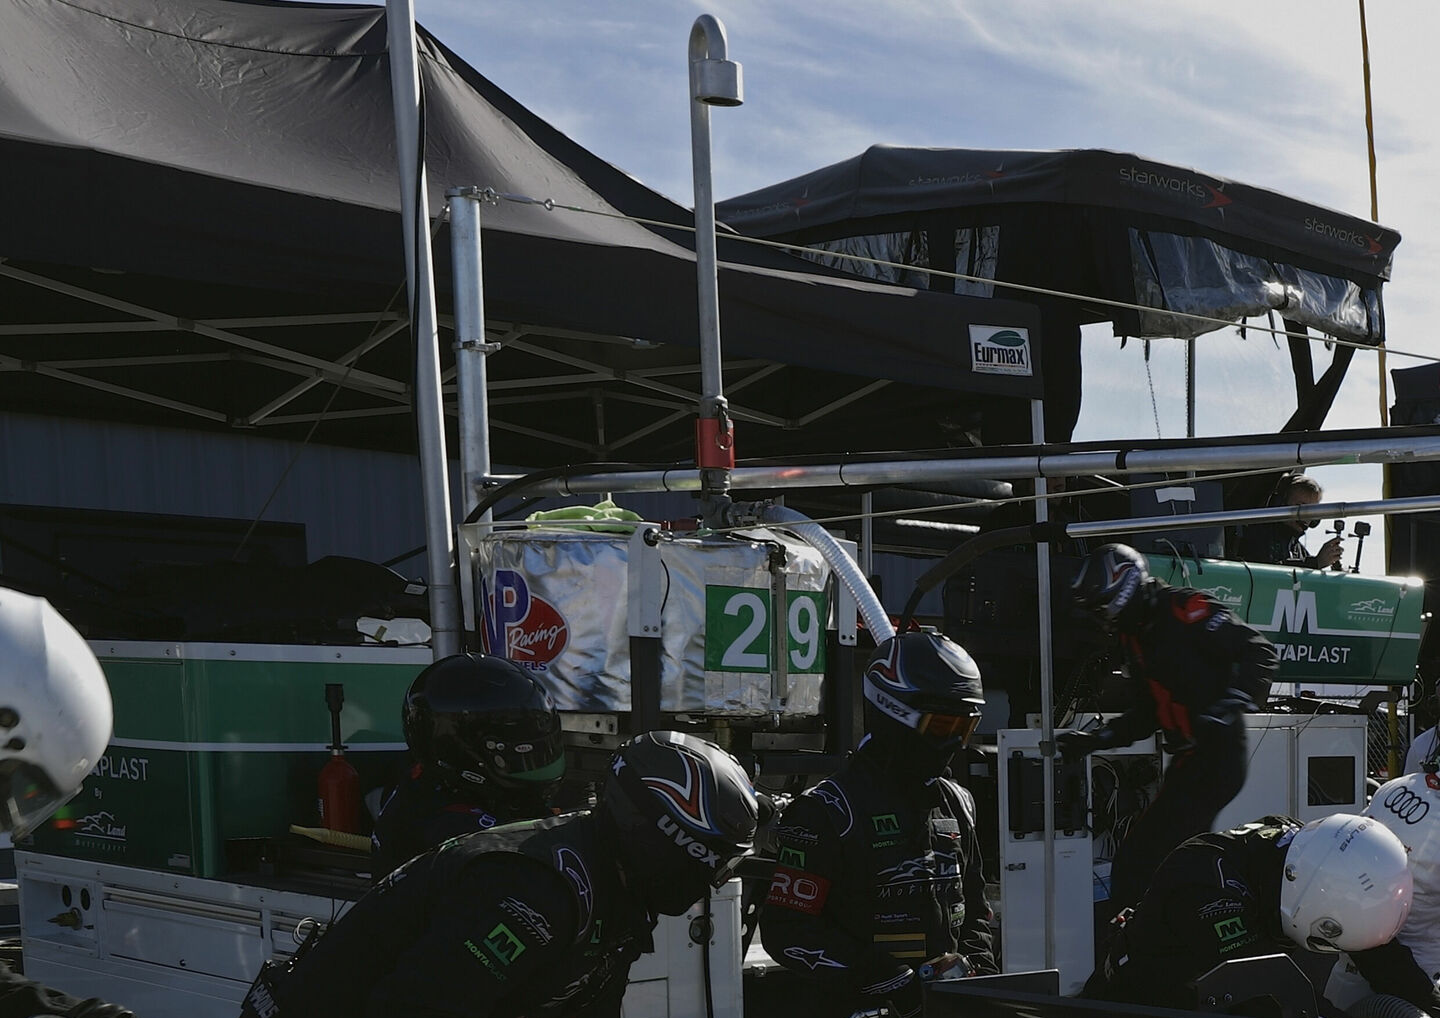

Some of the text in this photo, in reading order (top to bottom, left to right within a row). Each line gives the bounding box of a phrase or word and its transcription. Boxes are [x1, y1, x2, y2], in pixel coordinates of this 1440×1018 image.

[1119, 166, 1206, 198] starworks
[1304, 216, 1365, 248] starworks
[975, 342, 1025, 365] Eurmax
[482, 570, 530, 658] VP
[508, 622, 567, 659] Racing
[720, 591, 820, 670] 29
[1274, 643, 1351, 664] TAPLAST
[877, 693, 912, 722] uvex
[89, 755, 149, 781] APLAST
[656, 814, 721, 869] uvex
[770, 872, 819, 901] RO
